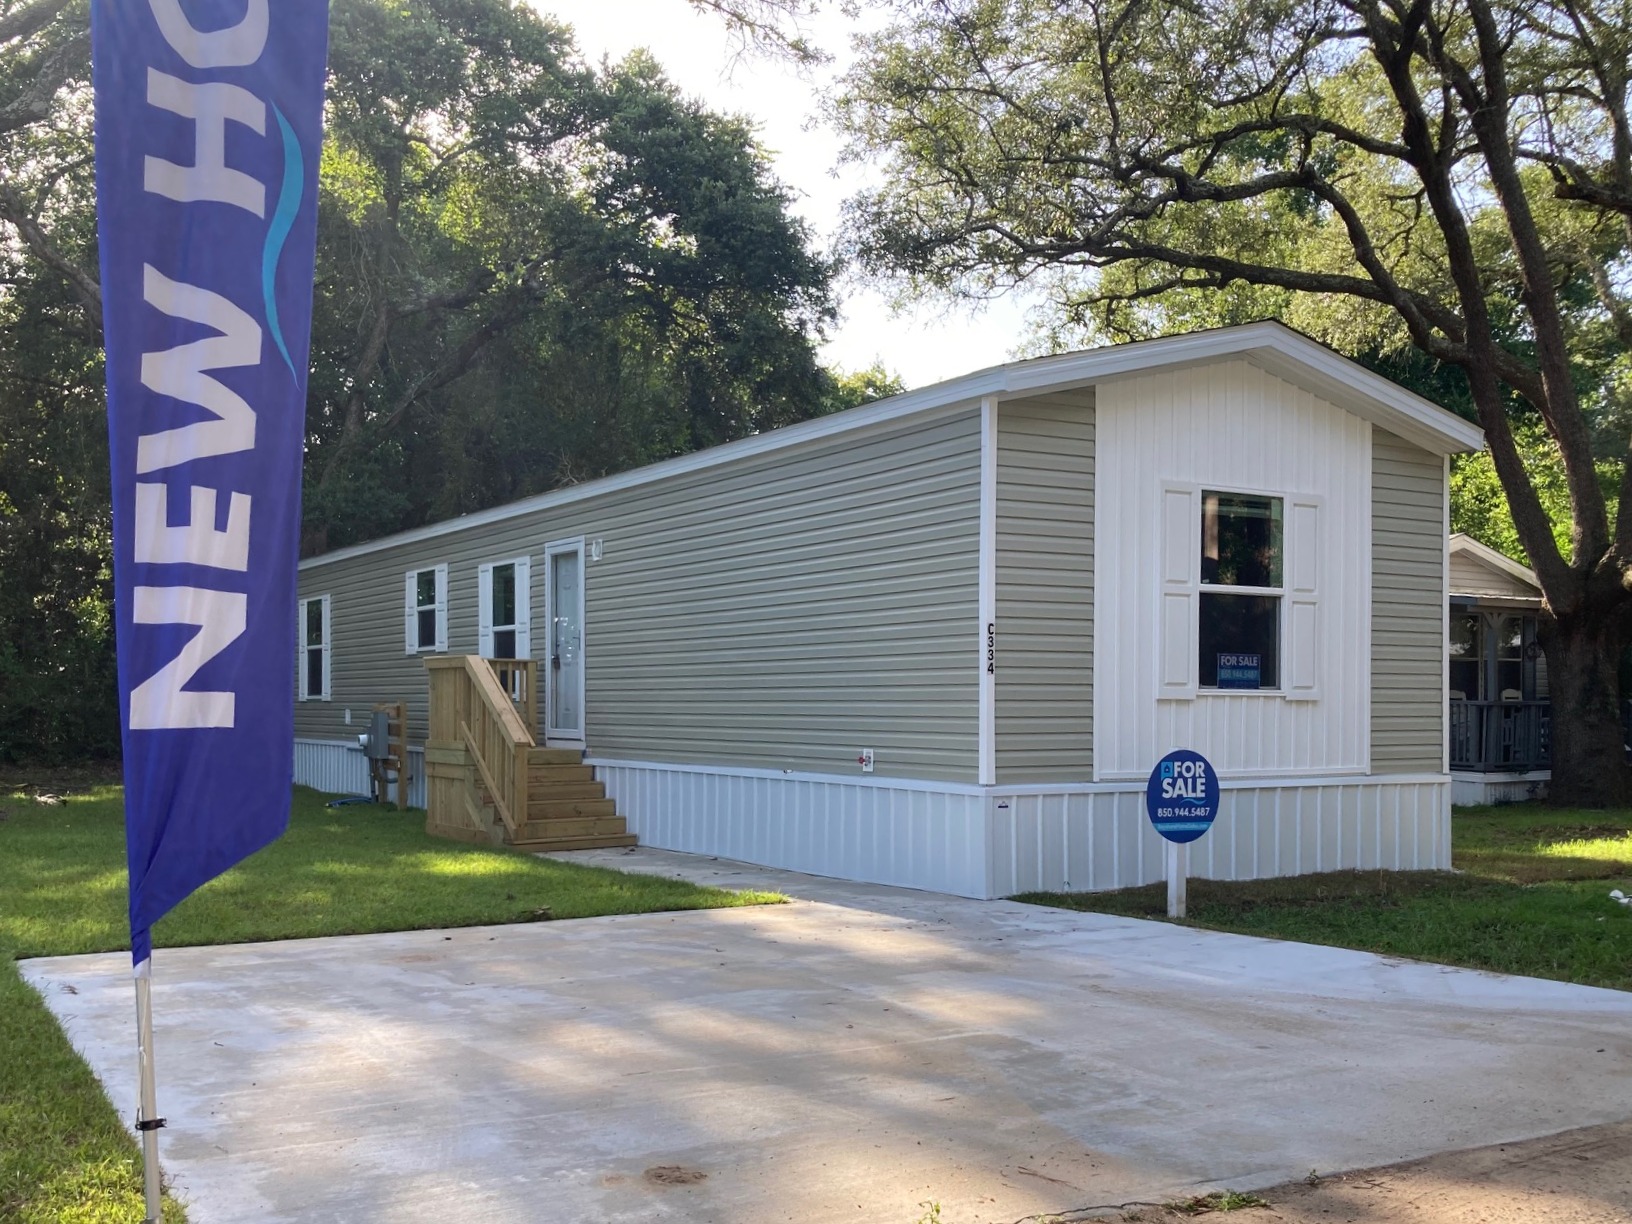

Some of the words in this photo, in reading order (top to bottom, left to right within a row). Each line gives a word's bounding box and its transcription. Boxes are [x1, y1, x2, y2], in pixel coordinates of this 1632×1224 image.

[129, 262, 262, 730] NEW
[987, 623, 995, 675] C334
[1220, 655, 1238, 666] FOR
[1238, 656, 1258, 667] SALE
[1173, 761, 1206, 778] FOR
[1161, 777, 1206, 799] SALE
[1157, 807, 1211, 818] 850.944.5487
